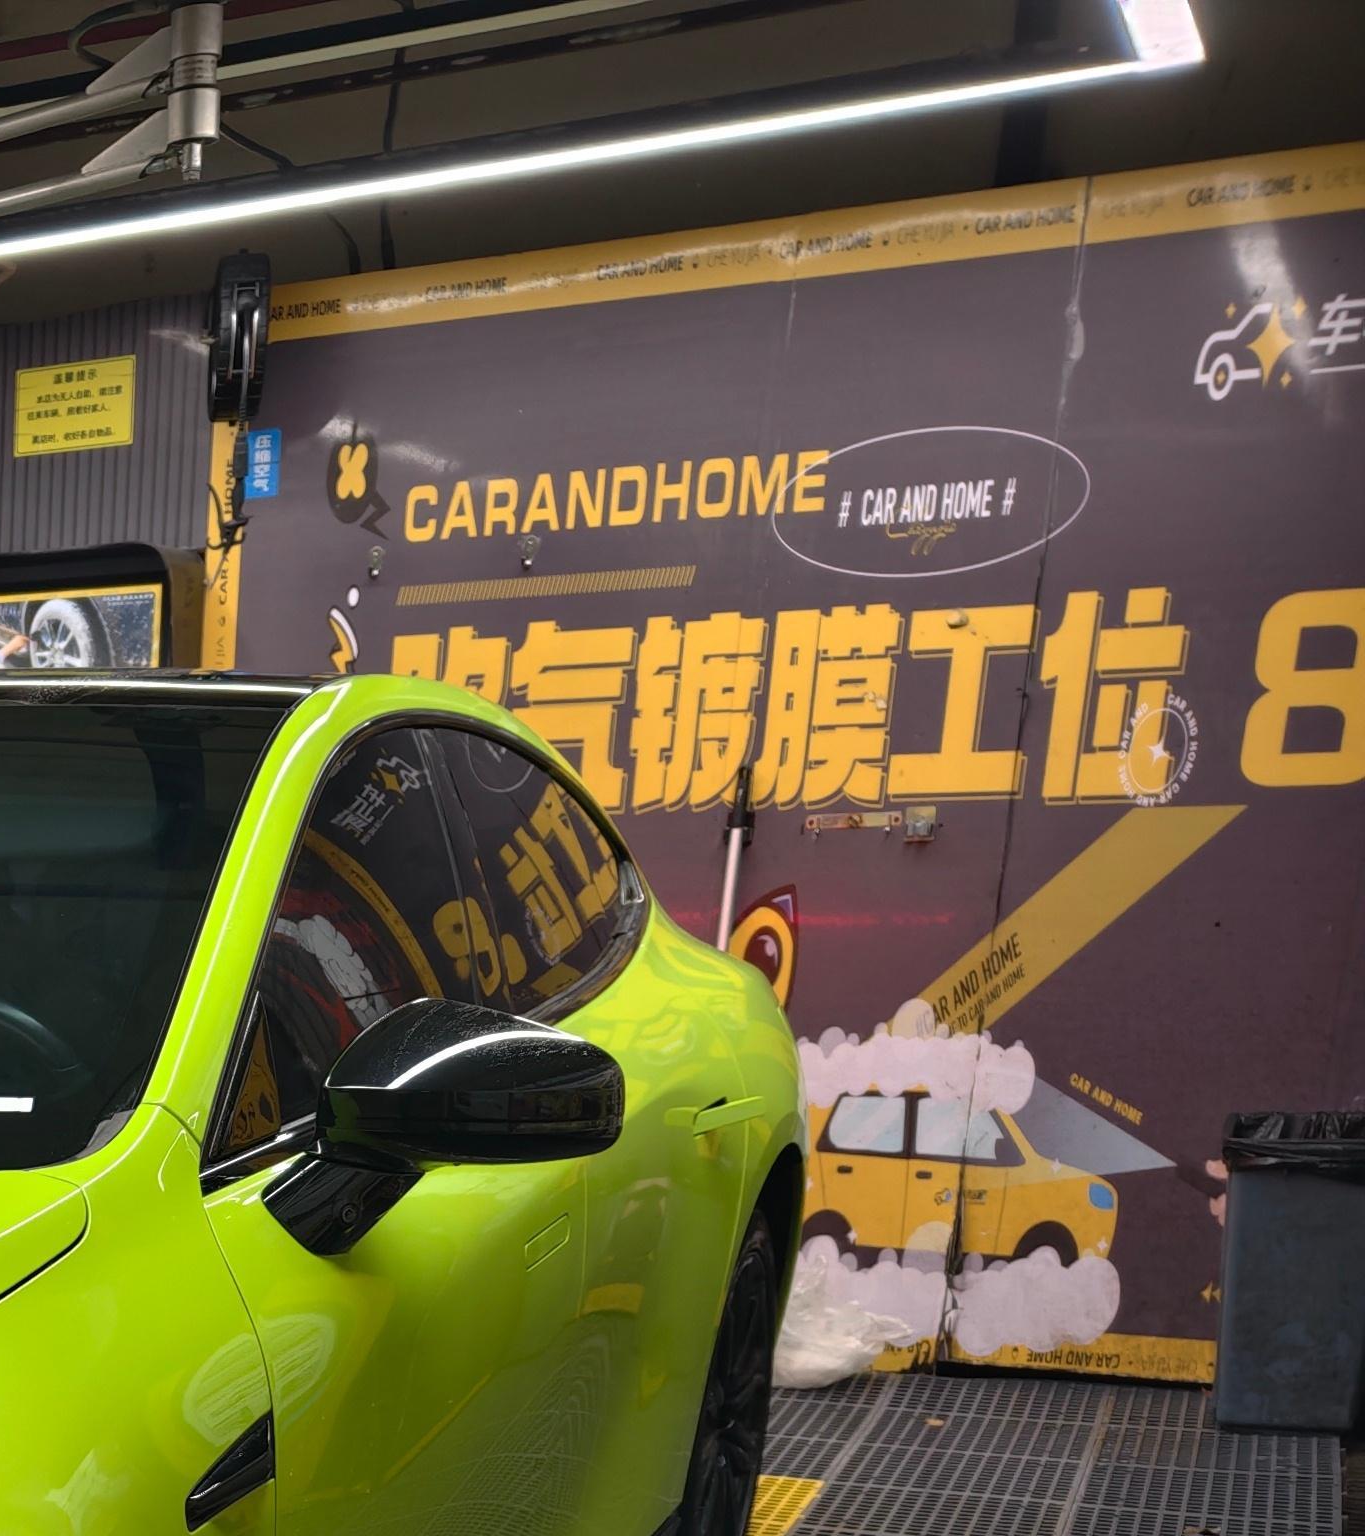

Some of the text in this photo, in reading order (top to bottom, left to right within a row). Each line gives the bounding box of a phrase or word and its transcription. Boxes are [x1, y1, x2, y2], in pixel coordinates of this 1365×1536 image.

[1187, 186, 1214, 207] CAR
[975, 205, 1076, 235] CAR AND HOME
[835, 231, 873, 252] HOME
[650, 255, 683, 273] HOME
[475, 277, 507, 294] HOME
[287, 303, 308, 319] AND
[311, 299, 341, 316] HOME
[404, 449, 830, 542] CARANDHOME
[838, 477, 1017, 527] # CAR AND HOME #
[1241, 587, 1365, 787] 8
[1185, 710, 1198, 737] AND
[1180, 741, 1198, 781] HOME
[953, 932, 1022, 1011] AND HOME
[1002, 963, 1026, 992] HOME
[1070, 1073, 1143, 1126] CAR AND HOME
[1027, 1348, 1121, 1369] CAR AND HOME
